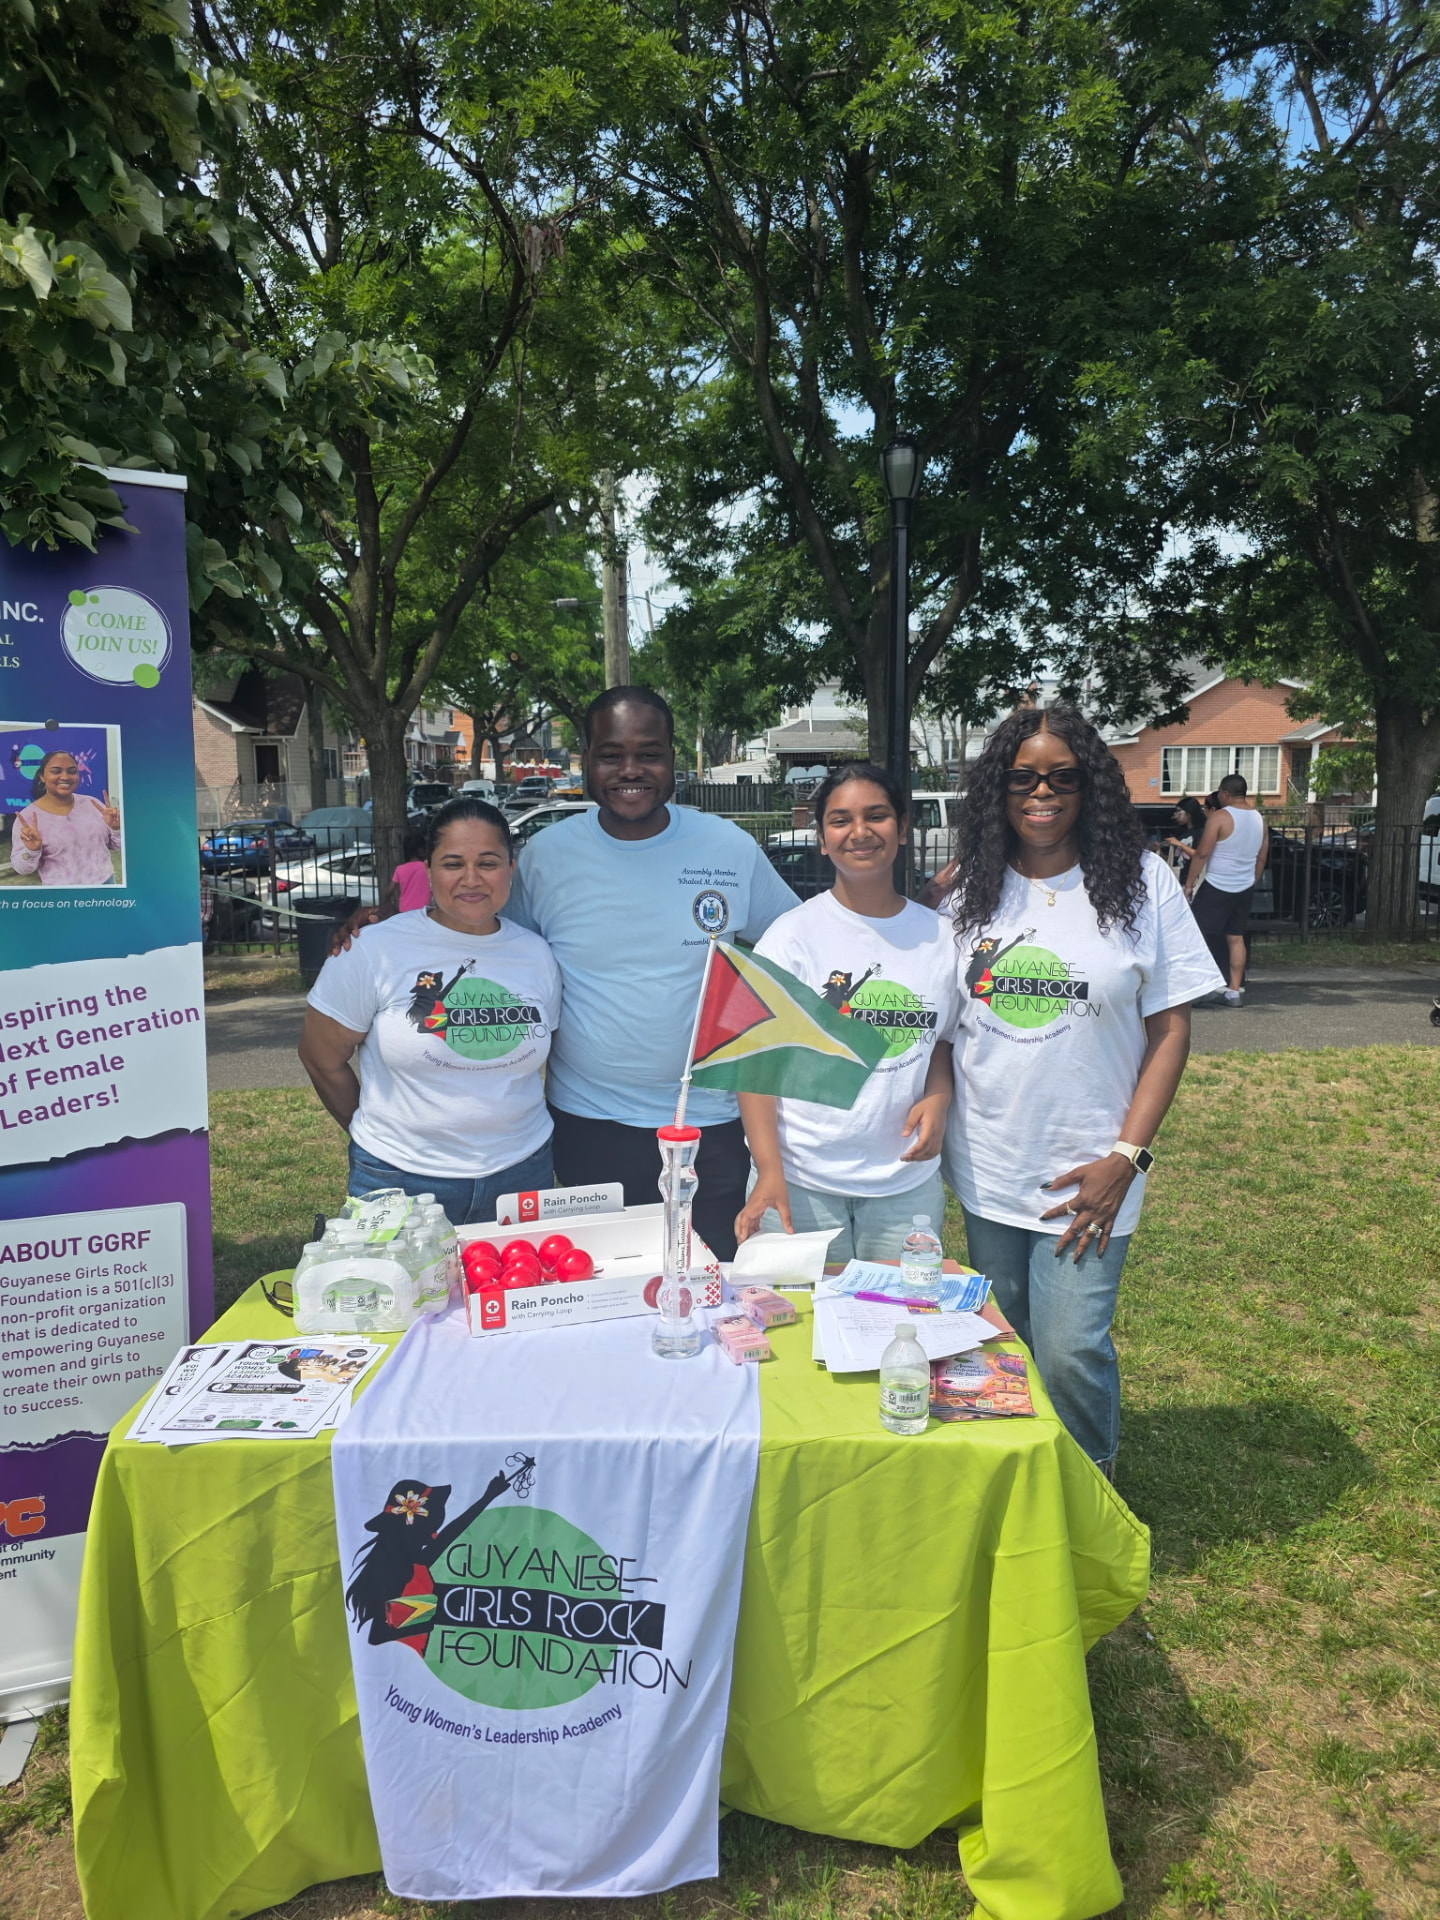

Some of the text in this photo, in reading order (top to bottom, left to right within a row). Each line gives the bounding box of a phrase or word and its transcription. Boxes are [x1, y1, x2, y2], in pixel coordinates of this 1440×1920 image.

[86, 611, 147, 631] COME
[75, 634, 158, 655] JOIN US!
[681, 868, 737, 877] Assembly Member
[11, 901, 19, 909] a
[22, 899, 55, 909] focus
[56, 900, 71, 909] on
[74, 898, 137, 909] technology.
[681, 938, 710, 946] Assembl
[997, 958, 1086, 978] GUYANESE
[105, 984, 148, 1007] the
[448, 992, 528, 1006] GUYANESE
[996, 977, 1082, 1000] GIRLS ROCK
[854, 993, 935, 1009] GUYANESE
[995, 995, 1101, 1017] FOUNDATION
[450, 1007, 536, 1025] GIRLS ROCK
[893, 1010, 934, 1029] ROCK
[55, 1006, 201, 1050] Generation
[976, 1015, 992, 1032] Young
[1044, 1024, 1071, 1041] Academy
[26, 1053, 125, 1090] Female
[0, 1084, 120, 1130] Leaders!
[543, 1193, 608, 1208] Rain Poncho
[558, 1205, 583, 1214] Carrying
[0, 1230, 151, 1264] ABOUT GGRF
[0, 1261, 148, 1289] Guyanese Girls Rock
[0, 1273, 174, 1307] Foundation is a 501(c)(3)
[1, 1296, 166, 1325] non-profit organization
[511, 1298, 537, 1310] Rain
[541, 1293, 584, 1307] Poncho
[511, 1308, 573, 1321] with Carrying Loop
[1, 1316, 138, 1343] that is dedicated to
[2, 1331, 165, 1361] empowering Guyanese
[2, 1352, 140, 1379] women and girls to
[3, 1365, 164, 1397] create their own paths
[3, 1396, 83, 1415] to success.
[11, 1541, 24, 1552] of
[0, 1549, 56, 1567] mmunity
[445, 1543, 658, 1594] GUYANESE
[443, 1586, 651, 1646] GIRLS ROCK
[439, 1629, 693, 1694] FOUNDATION
[384, 1684, 622, 1745] Young Women's Leadership Academy
